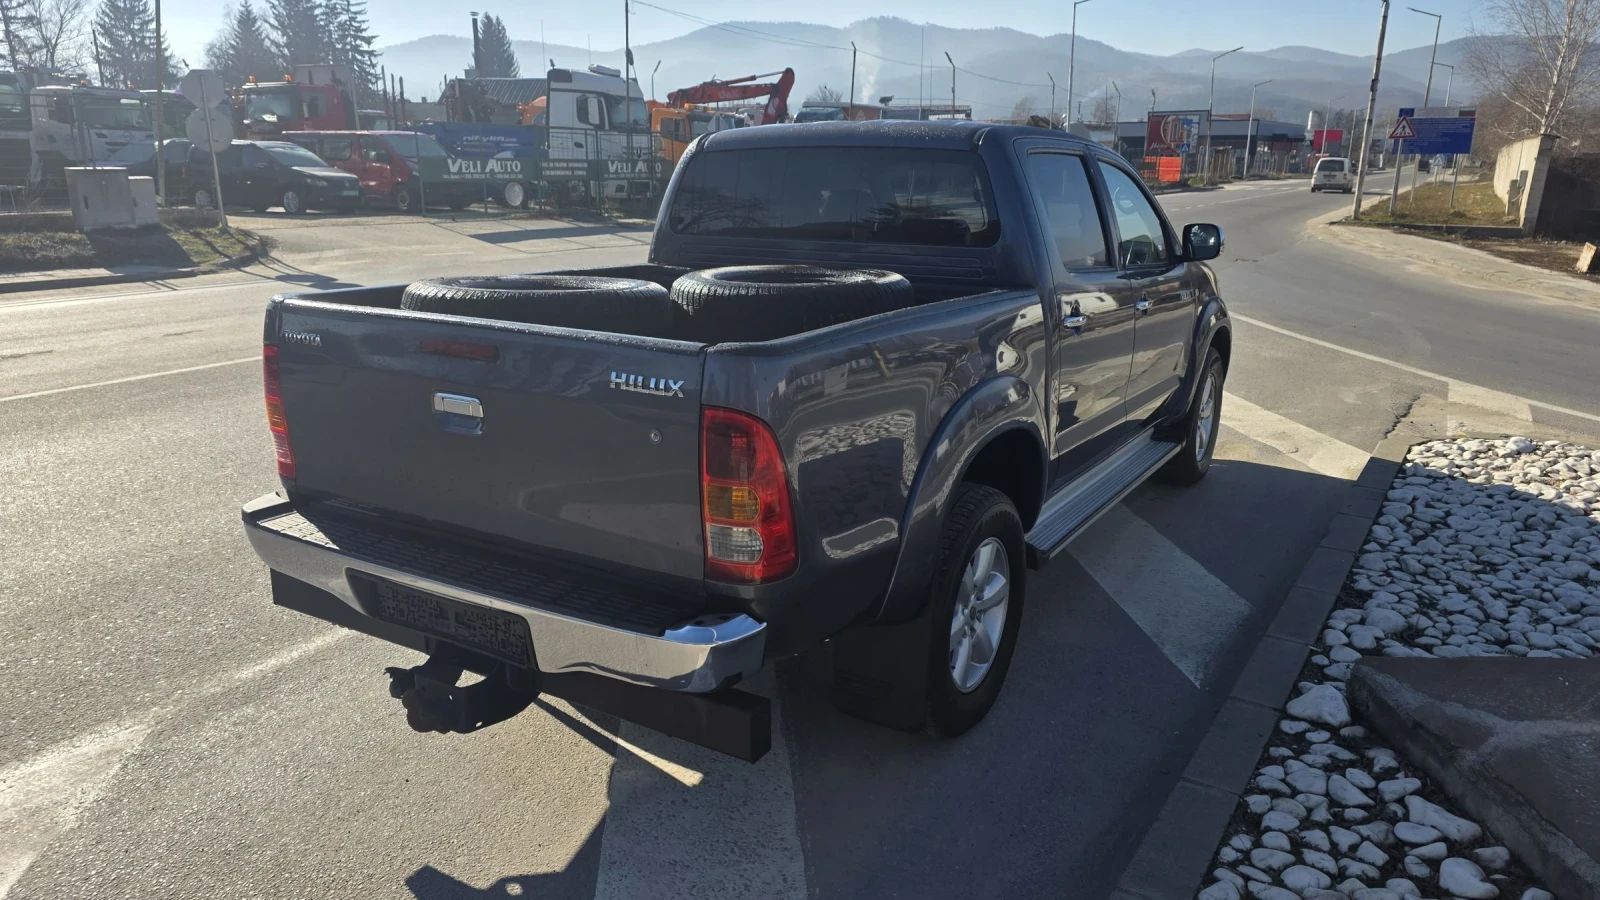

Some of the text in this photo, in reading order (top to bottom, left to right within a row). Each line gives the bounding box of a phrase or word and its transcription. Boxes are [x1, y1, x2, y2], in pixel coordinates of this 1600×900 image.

[484, 158, 521, 173] AUTO
[284, 329, 322, 347] TOYOTA
[610, 371, 685, 398] HILUX
